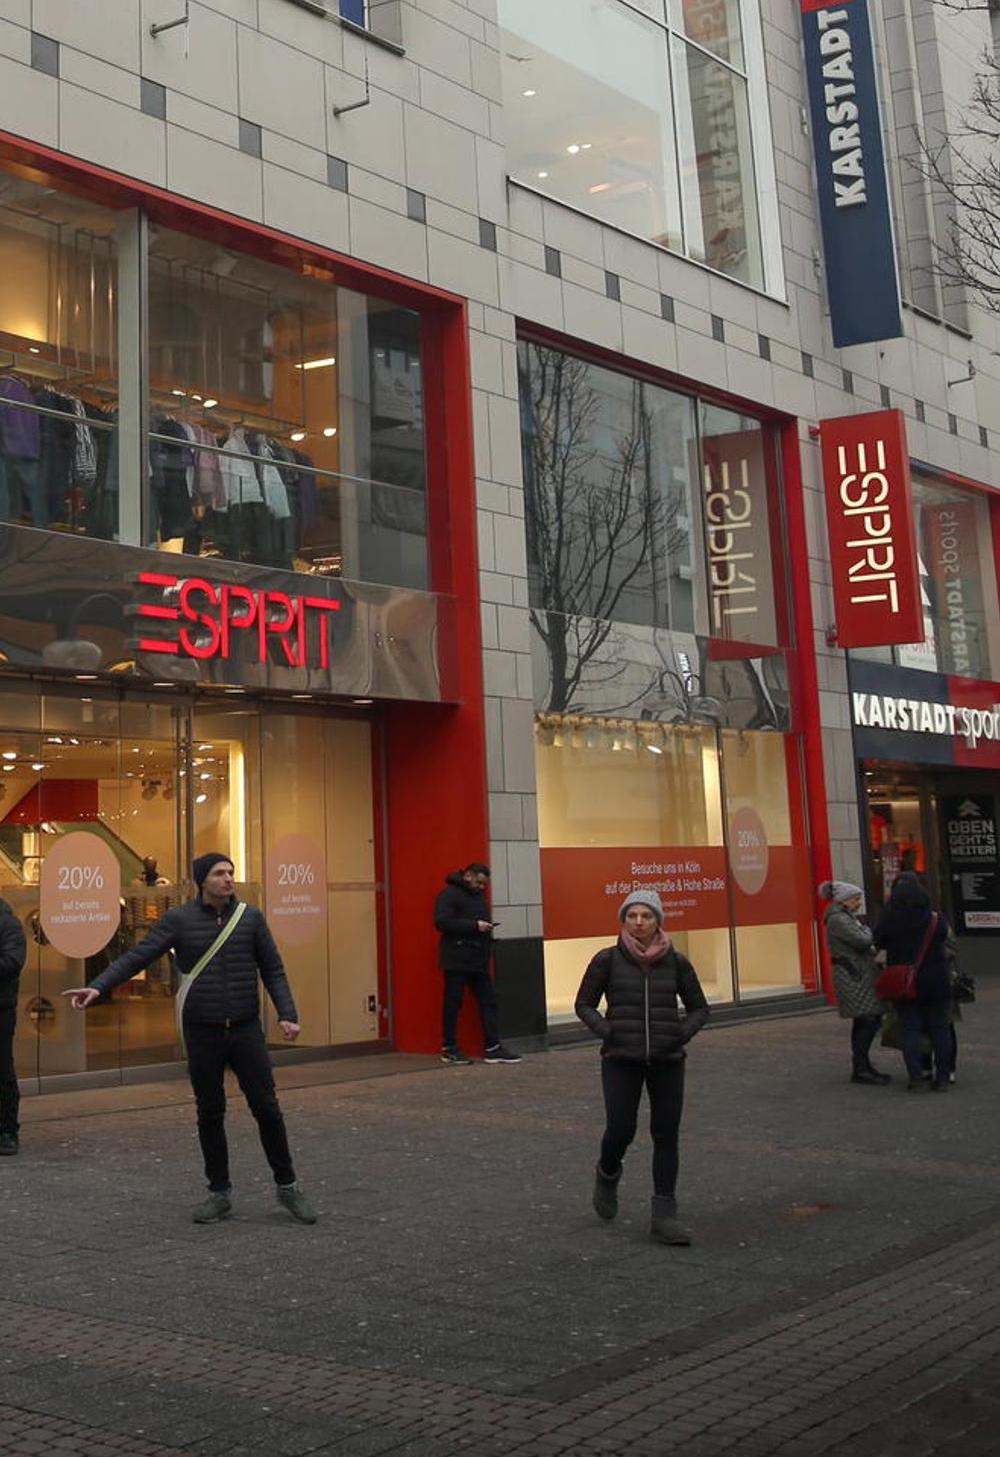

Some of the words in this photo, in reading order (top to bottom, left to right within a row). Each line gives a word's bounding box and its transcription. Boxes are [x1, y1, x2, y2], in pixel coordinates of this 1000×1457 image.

[817, 7, 869, 208] KARSTADT
[838, 440, 899, 613] ESPRIT
[138, 571, 341, 669] ESPRIT
[853, 692, 955, 736] KARSTADT
[947, 819, 995, 834] OBEN
[58, 865, 104, 890] 20%
[277, 863, 315, 885] 20%
[631, 862, 663, 875] Besuche
[663, 863, 677, 873] uns
[685, 861, 701, 873] Köln
[605, 881, 618, 894] auf
[619, 881, 632, 894] der
[684, 878, 702, 892] Hohe
